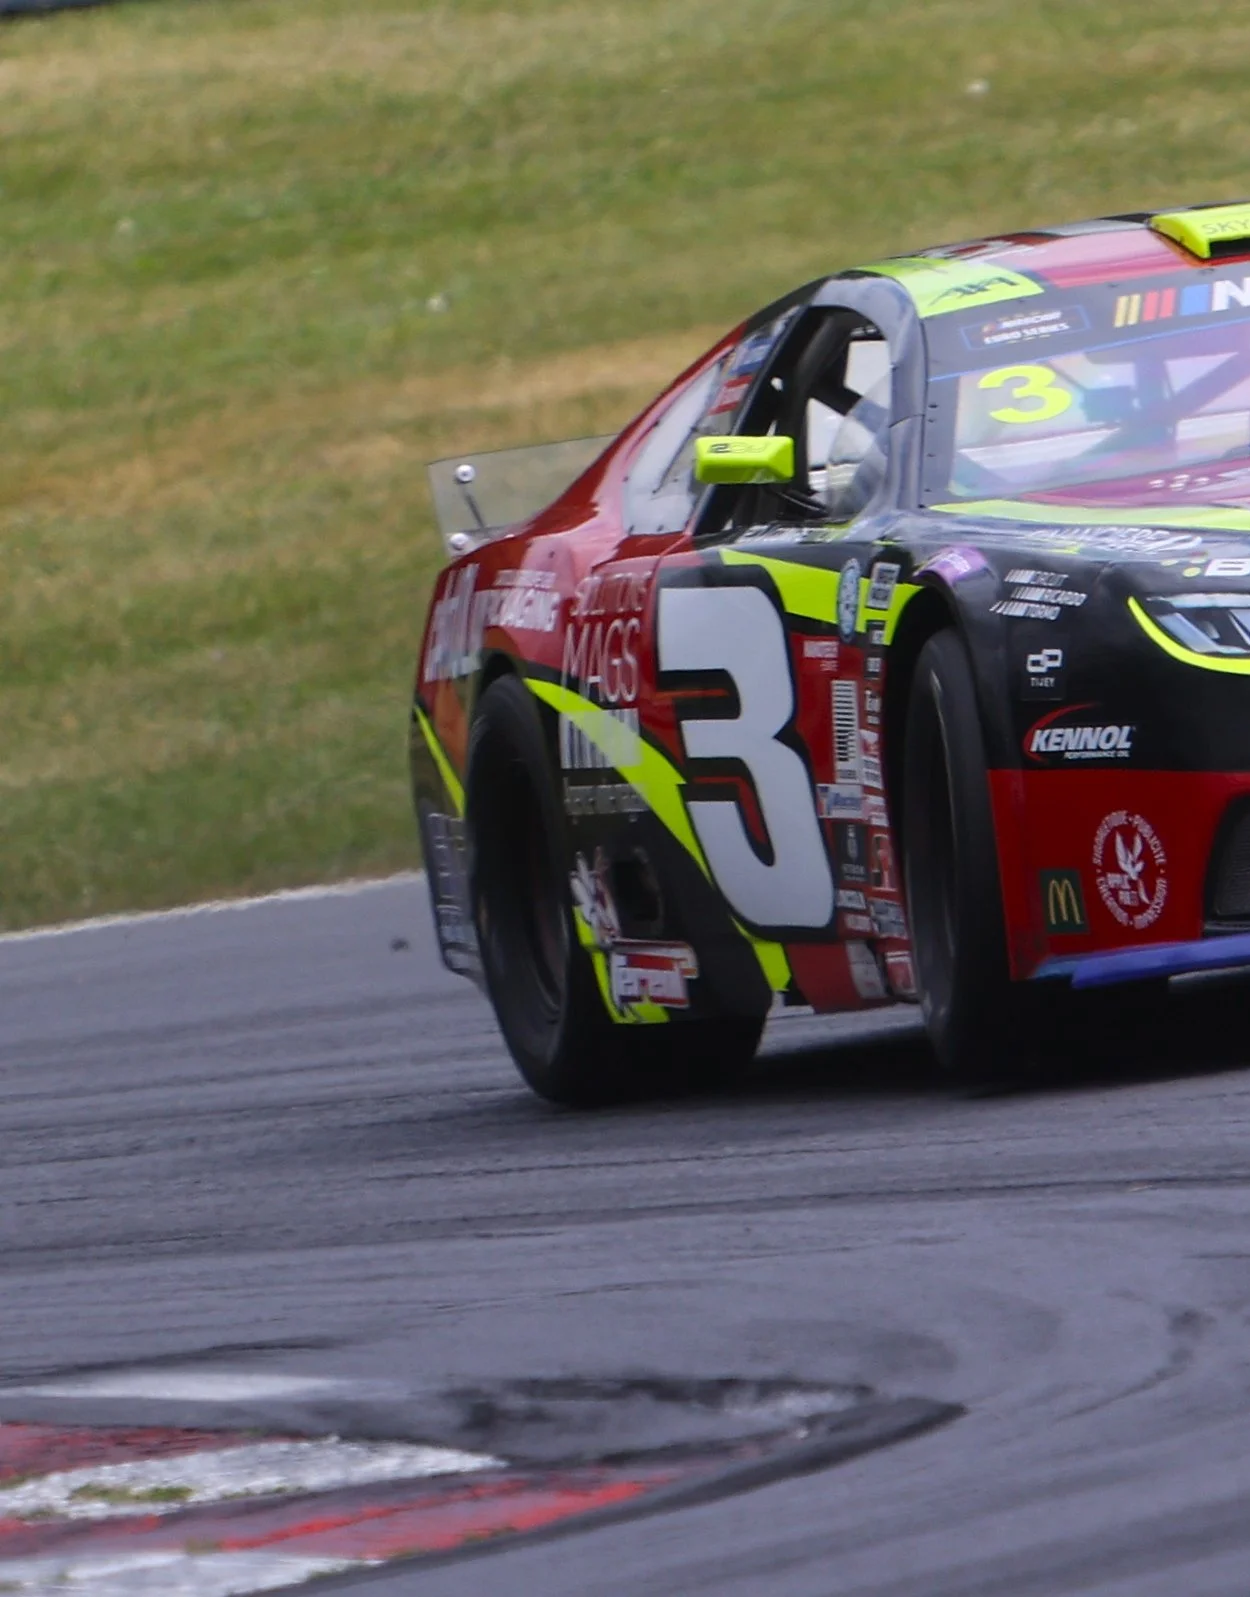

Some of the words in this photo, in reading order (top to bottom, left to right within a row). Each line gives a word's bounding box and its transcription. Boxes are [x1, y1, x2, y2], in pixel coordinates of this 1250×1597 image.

[978, 365, 1072, 424] 3
[560, 617, 641, 704] MAGS
[658, 586, 836, 930] 3
[1030, 725, 1133, 752] KENNOL
